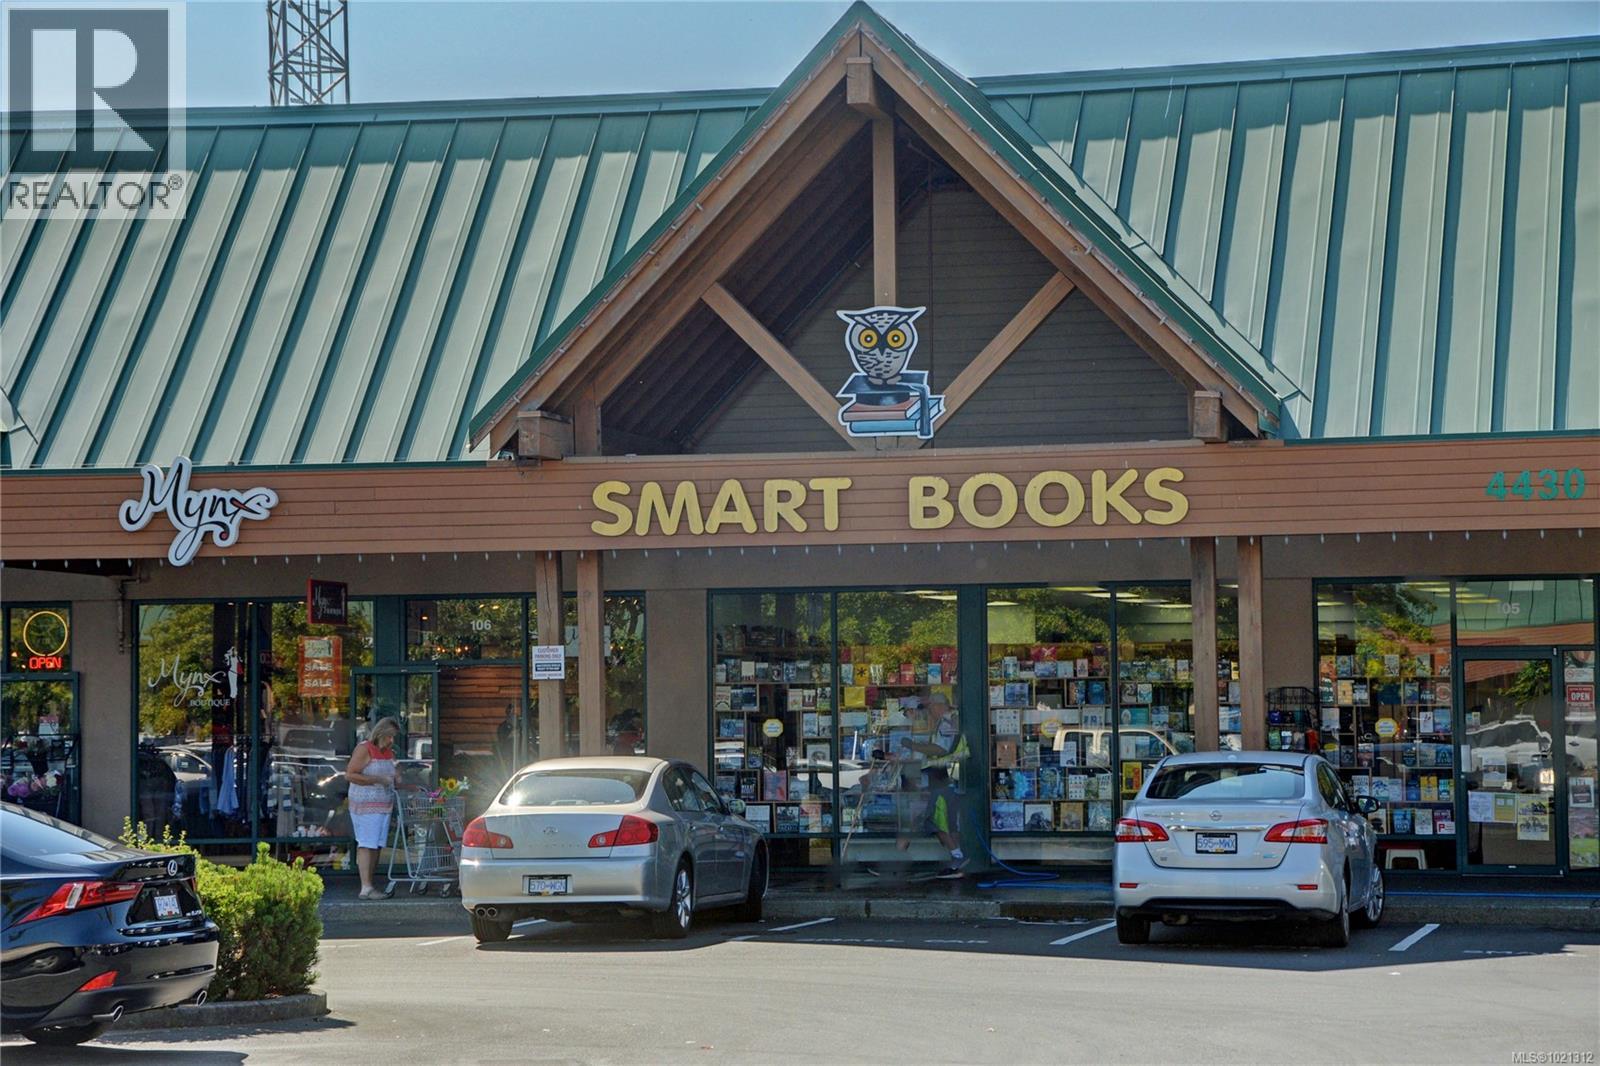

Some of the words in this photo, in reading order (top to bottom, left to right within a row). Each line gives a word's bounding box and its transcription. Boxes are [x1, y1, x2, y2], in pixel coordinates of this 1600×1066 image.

[1485, 467, 1586, 501] 4430
[590, 476, 853, 538] SMART
[907, 467, 1190, 530] BOOKS
[122, 460, 274, 563] Mynx
[1498, 602, 1521, 615] 05
[470, 619, 492, 632] 106
[28, 656, 63, 670] OPEN
[147, 653, 227, 708] Mynx
[304, 679, 334, 688] SALE
[1570, 691, 1591, 701] OPEN
[189, 698, 231, 708] BOUTIQUE
